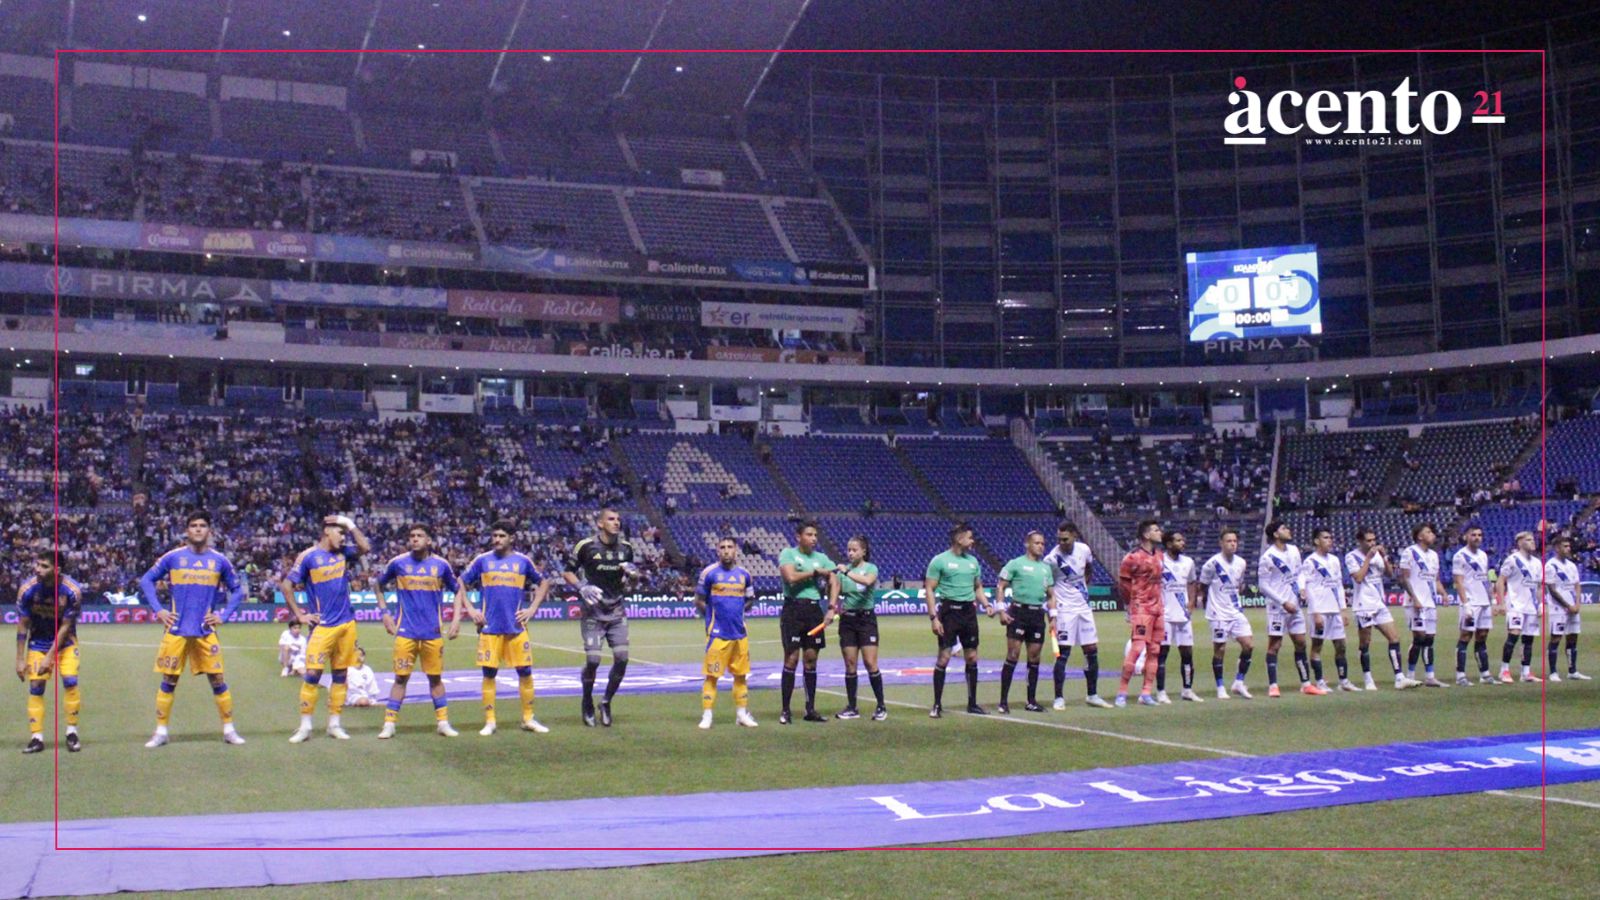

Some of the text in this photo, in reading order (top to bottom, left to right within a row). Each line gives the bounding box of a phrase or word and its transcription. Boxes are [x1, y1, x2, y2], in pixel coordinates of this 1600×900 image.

[660, 261, 727, 275] caliente.mx
[90, 273, 216, 300] PIRMA
[1235, 312, 1271, 325] 00:00
[1204, 337, 1284, 353] PIRMA
[856, 792, 1085, 821] La
[1083, 769, 1386, 802] Liga
